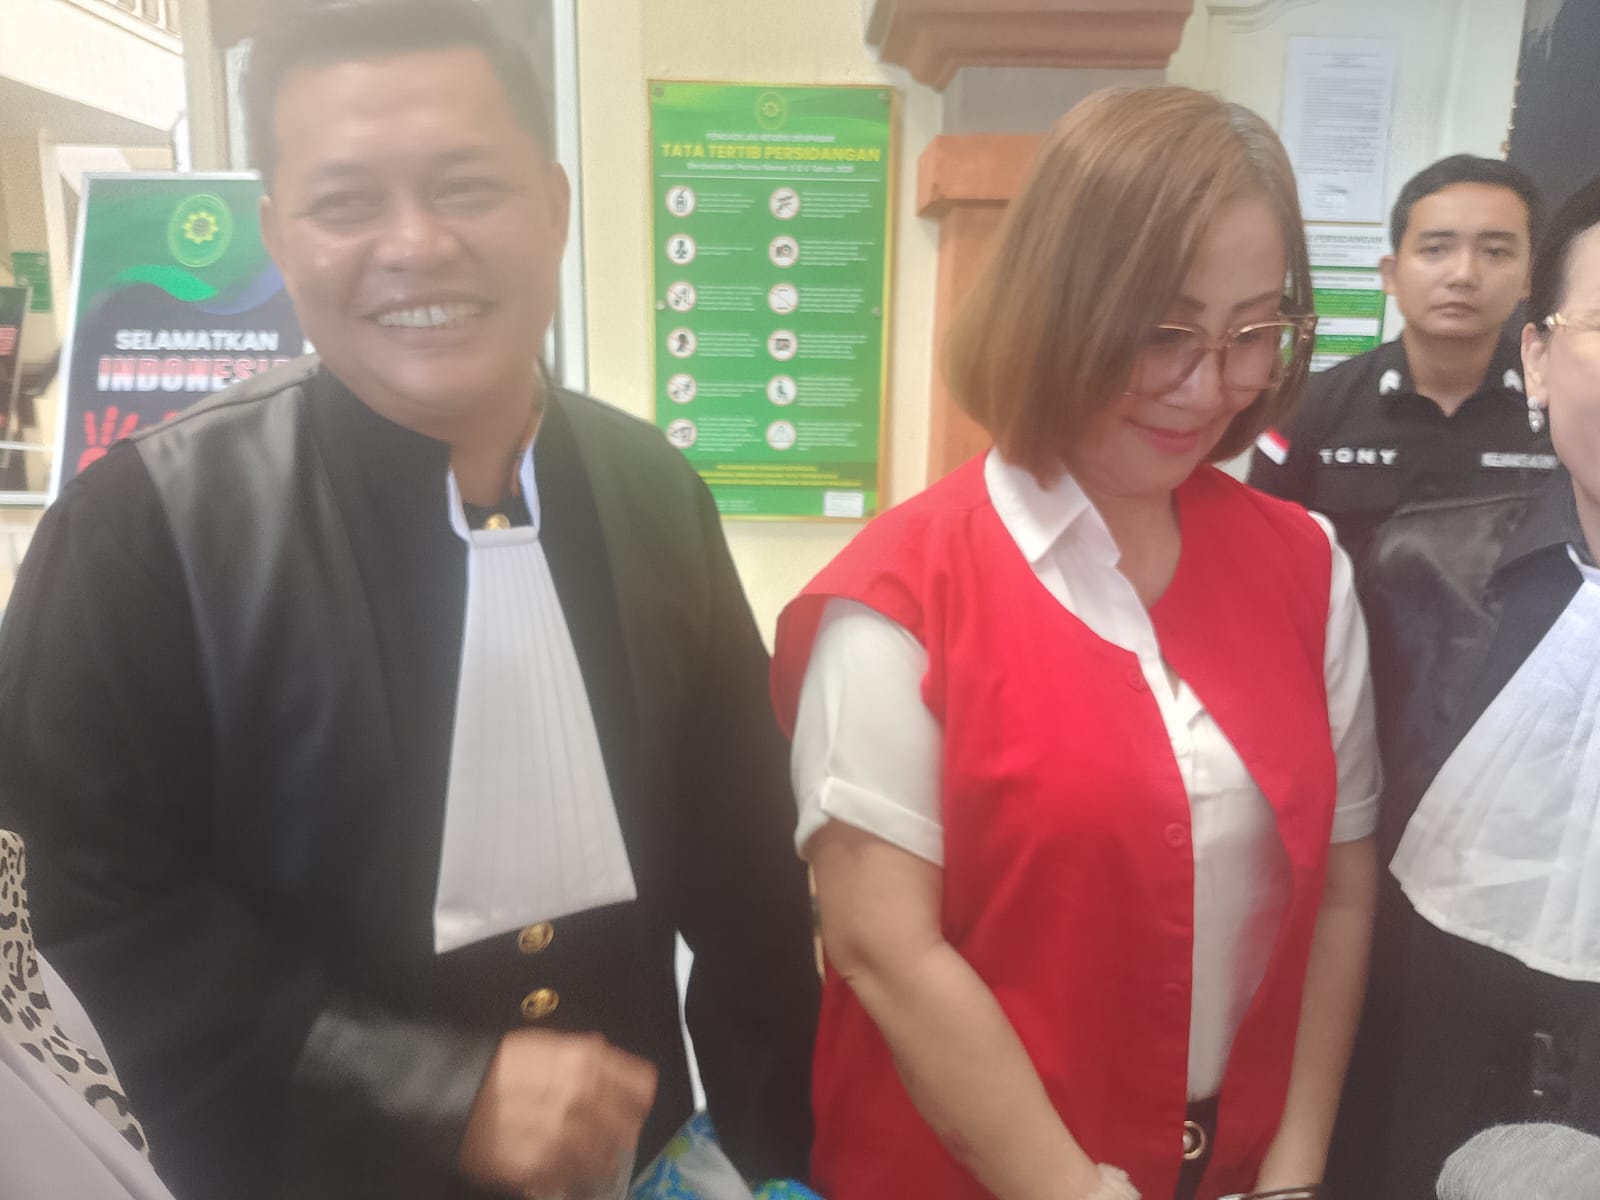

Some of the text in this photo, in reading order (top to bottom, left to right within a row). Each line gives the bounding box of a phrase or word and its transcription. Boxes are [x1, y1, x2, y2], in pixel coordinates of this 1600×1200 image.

[661, 143, 881, 162] TATA TERTIB PERSIDANGAN
[115, 329, 280, 351] SELAMATKAN
[97, 356, 290, 392] INDONESI
[1318, 448, 1398, 465] TONY
